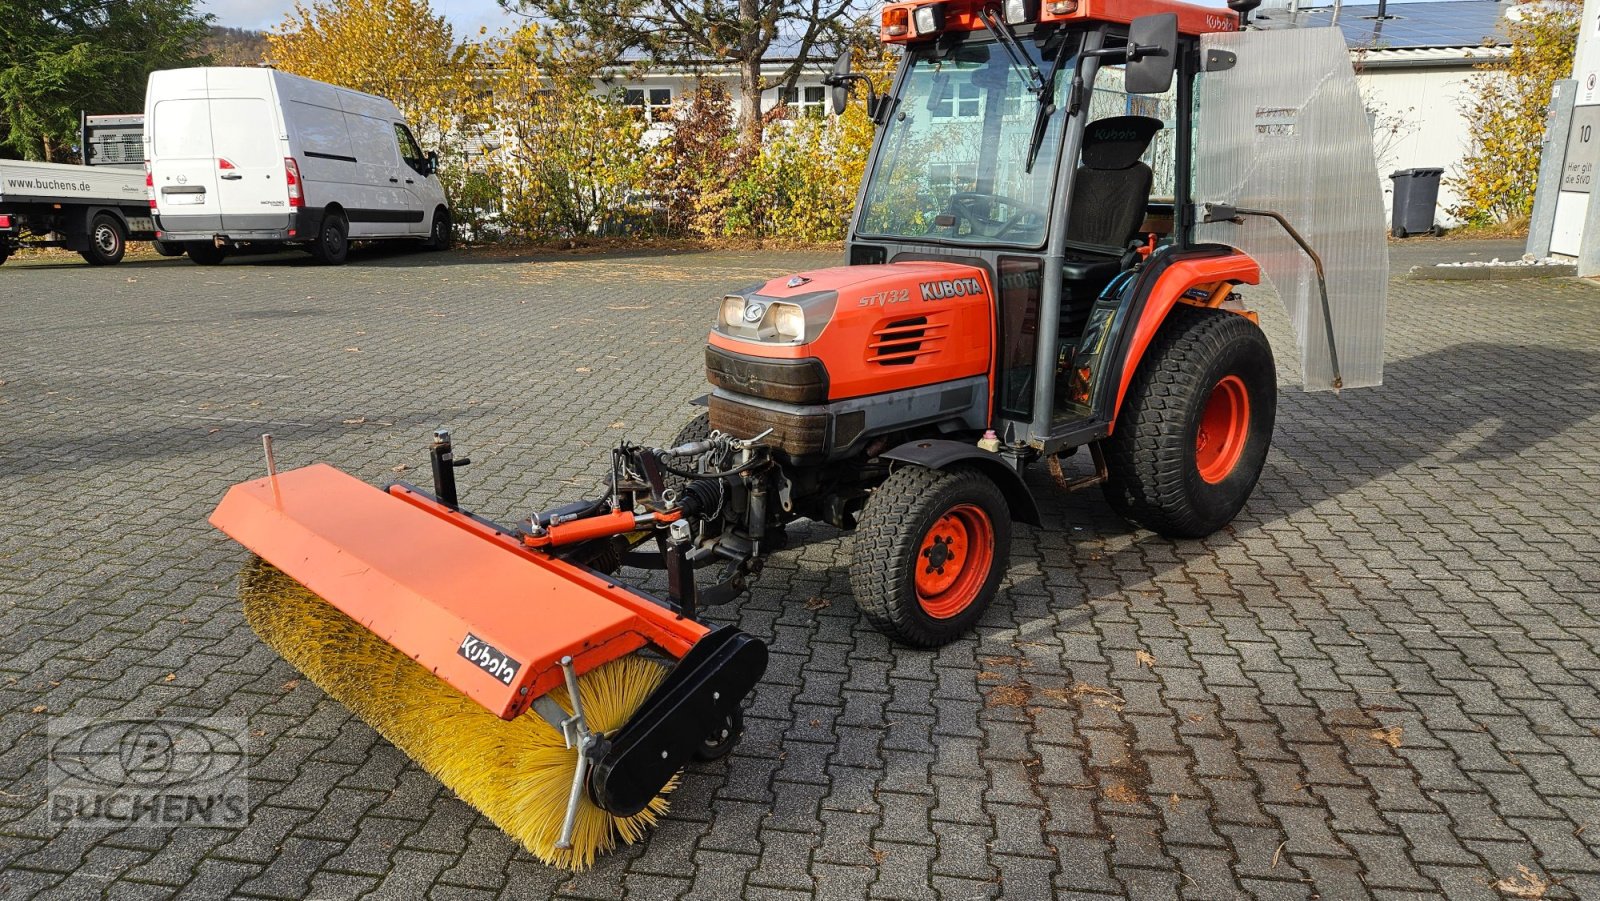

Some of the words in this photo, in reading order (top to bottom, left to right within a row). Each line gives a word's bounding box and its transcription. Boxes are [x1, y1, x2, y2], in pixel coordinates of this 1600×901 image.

[1206, 14, 1233, 31] Kubota
[1580, 125, 1591, 143] 10
[8, 179, 91, 192] www.buchens.de
[919, 278, 983, 302] KUBOTA
[461, 635, 515, 684] Kubota
